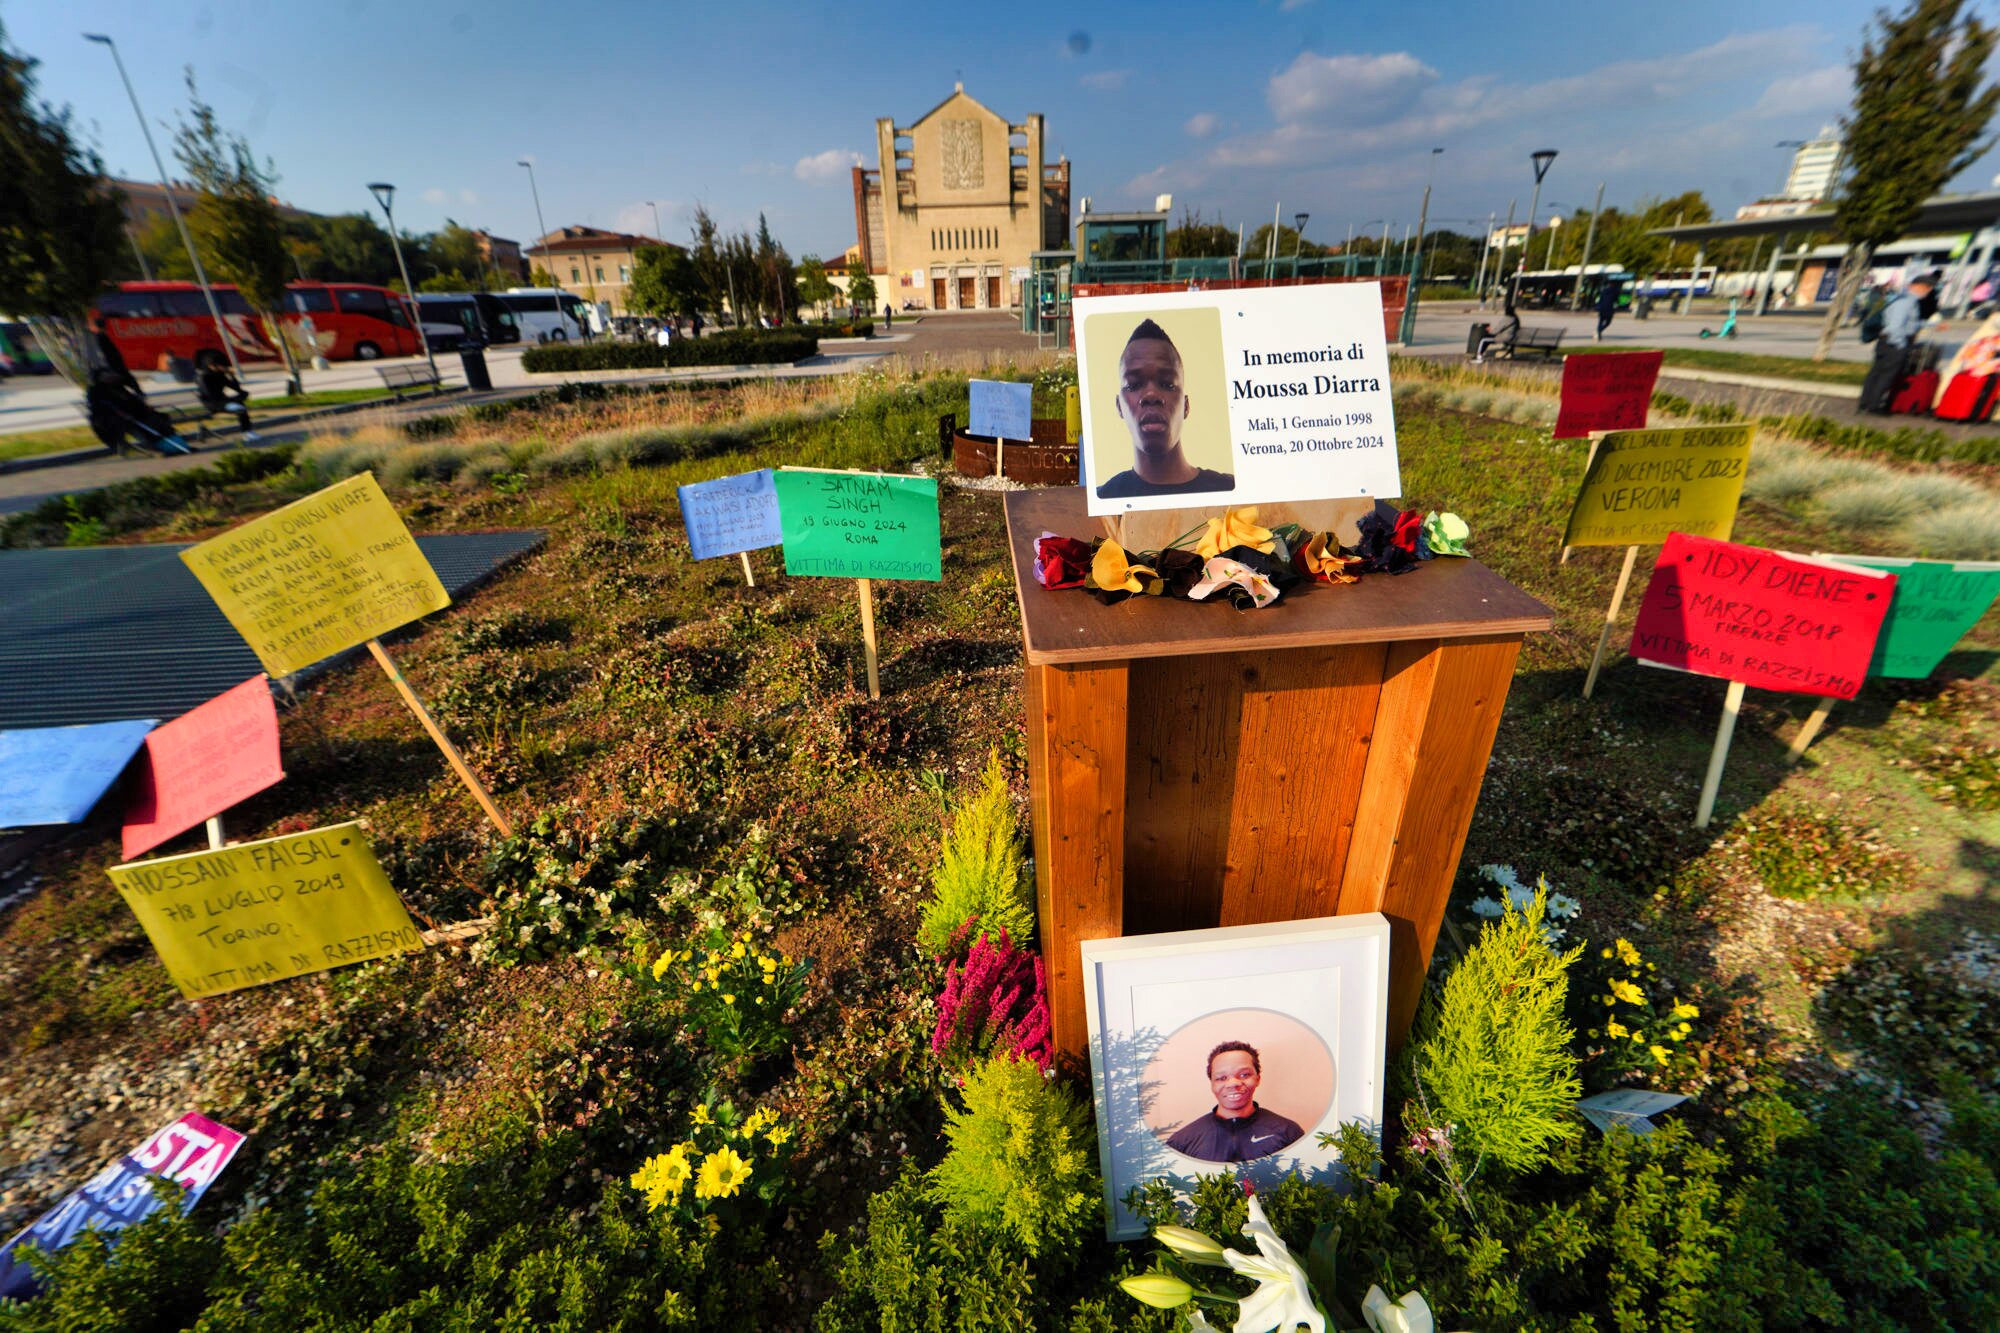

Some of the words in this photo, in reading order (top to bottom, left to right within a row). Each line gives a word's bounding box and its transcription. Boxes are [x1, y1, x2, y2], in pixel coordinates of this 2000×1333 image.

[1243, 349, 1262, 366] In
[1266, 345, 1343, 365] memoria
[1347, 343, 1364, 360] di
[1232, 379, 1309, 400] Moussa
[1314, 375, 1381, 395] Diarra
[1247, 418, 1279, 432] Mali,
[1282, 418, 1288, 430] 1
[1291, 414, 1342, 429] Gennaio
[1345, 412, 1373, 425] 1998
[1240, 442, 1287, 455] Verona,
[1290, 440, 1304, 452] 20
[1307, 437, 1353, 452] Ottobre
[1356, 435, 1384, 448] 2024
[1614, 458, 1695, 483] DICEMBRE
[1698, 458, 1743, 479] 2023
[326, 486, 372, 515] WIAFE
[820, 478, 892, 500] SATNAM
[1602, 487, 1681, 512] VERONA
[826, 496, 882, 514] SINGH
[803, 515, 815, 527] 19
[823, 516, 867, 529] GIUGNO
[874, 519, 907, 533] 2024
[845, 533, 879, 545] ROMA
[789, 558, 846, 574] VITTIMA
[851, 559, 863, 573] DI
[868, 558, 934, 575] RAZZISMO
[1701, 549, 1760, 584] IDY
[1764, 565, 1861, 602] DIENE
[228, 569, 276, 596] KARIM
[354, 588, 435, 632] RAZZISMO
[1660, 584, 1684, 611] 5
[1689, 592, 1773, 628] MARZO
[1783, 613, 1844, 641] 2018
[1638, 631, 1711, 660] VITTIMA
[1714, 621, 1790, 647] FIRENZE
[126, 854, 238, 897] HOSSAIN
[251, 837, 341, 873] FAISAL
[202, 885, 285, 917] LUGLIO
[295, 872, 346, 895] 2019
[181, 960, 280, 993] VITTIMA
[322, 925, 419, 965] RAZZISMO
